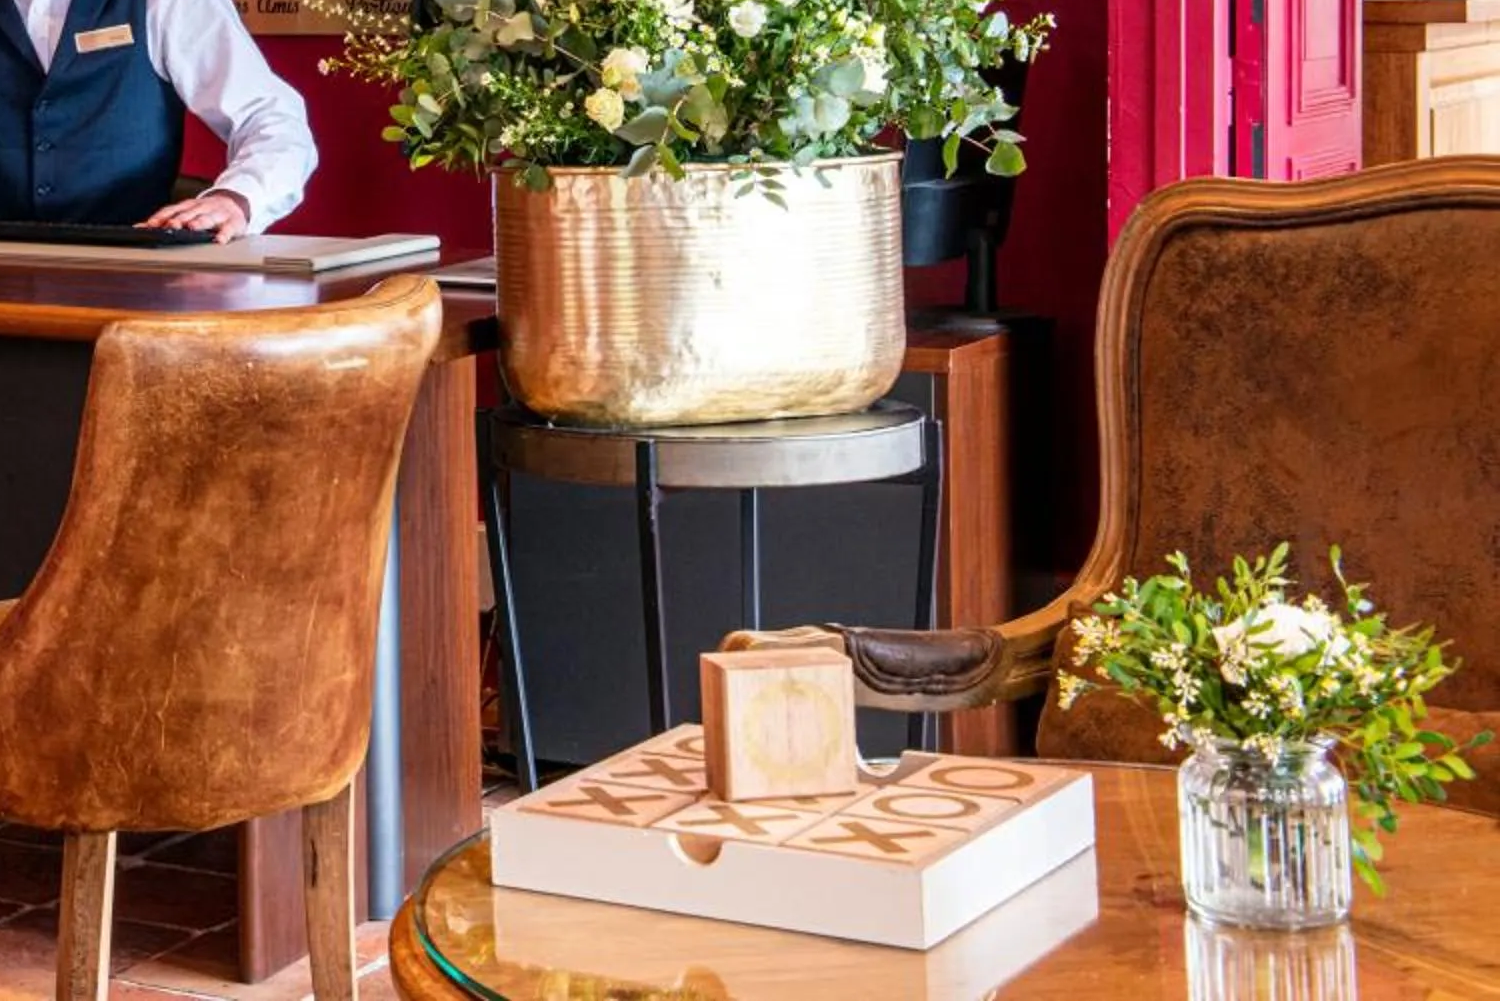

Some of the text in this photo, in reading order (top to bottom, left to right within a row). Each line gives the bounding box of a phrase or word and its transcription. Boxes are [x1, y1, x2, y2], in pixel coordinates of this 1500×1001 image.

[546, 786, 668, 815] X
[676, 804, 800, 835] X
[810, 821, 937, 854] X
